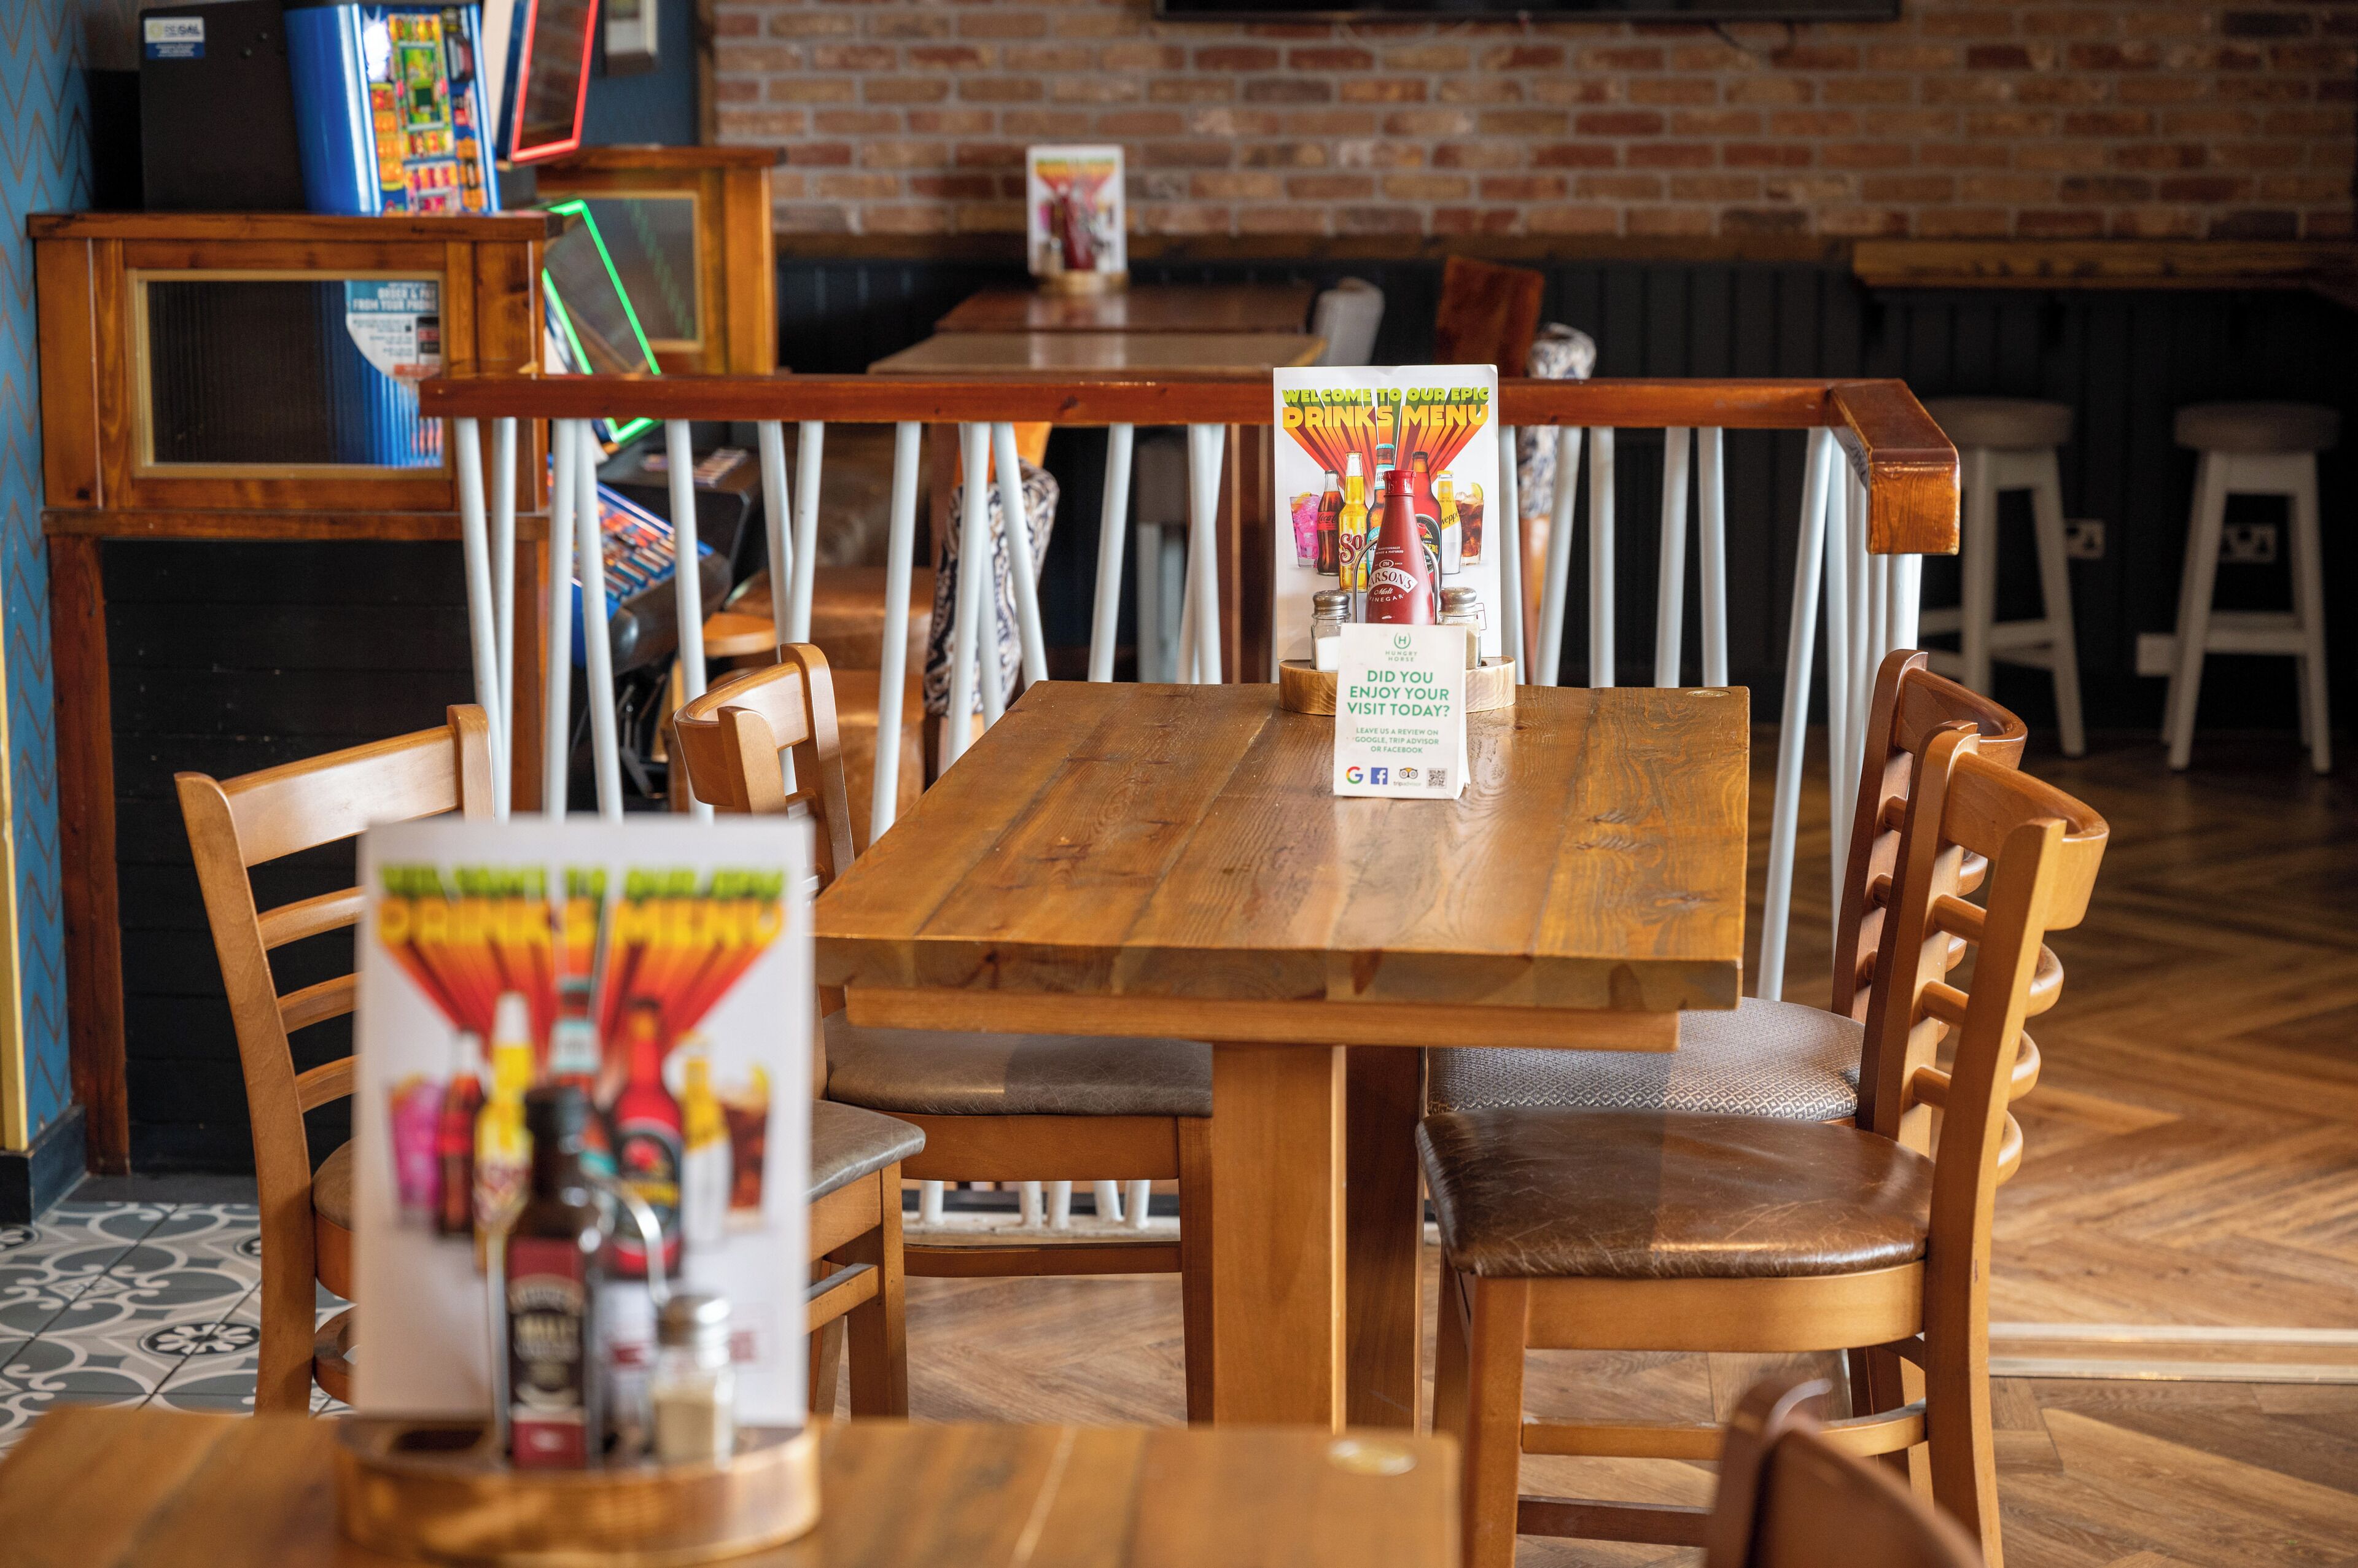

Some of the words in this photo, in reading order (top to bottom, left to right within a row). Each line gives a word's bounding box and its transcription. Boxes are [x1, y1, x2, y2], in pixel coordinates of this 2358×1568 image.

[1282, 388, 1371, 403] WELCOME
[1376, 388, 1402, 402] TO
[1407, 387, 1446, 402] OUR
[1450, 387, 1489, 401] EPIC
[1282, 405, 1393, 428] DRINKS
[1401, 404, 1489, 426] MENU
[1369, 570, 1414, 589] ARSON'S
[1369, 594, 1404, 602] VINEGAR
[1374, 587, 1393, 596] Malt
[1367, 670, 1395, 683] DID
[1399, 671, 1433, 683] YOU
[1350, 686, 1401, 699] ENJOY
[1404, 687, 1449, 701] YOUR
[1347, 702, 1386, 716] VISIT
[1390, 704, 1450, 717] TODAY?
